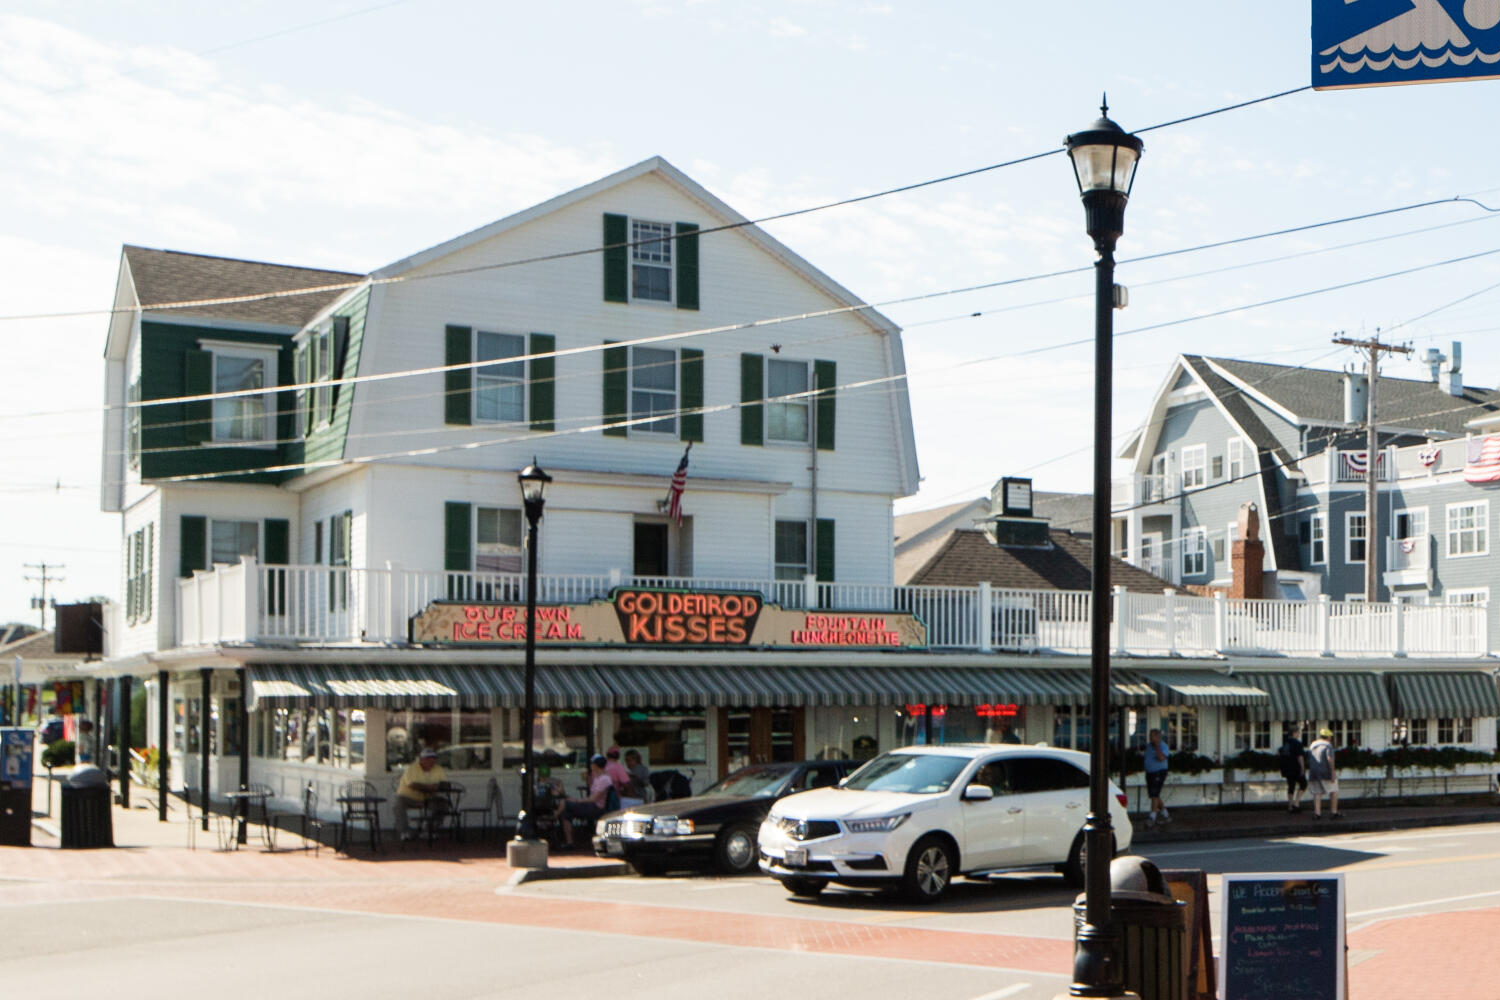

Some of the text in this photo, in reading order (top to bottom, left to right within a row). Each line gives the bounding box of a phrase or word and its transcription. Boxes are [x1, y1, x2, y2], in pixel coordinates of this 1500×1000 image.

[464, 606, 516, 622] OUR
[618, 592, 758, 617] GOLDENROD
[453, 622, 492, 642] ICE
[628, 613, 748, 643] KISSES
[806, 615, 886, 631] FOUNTAIN
